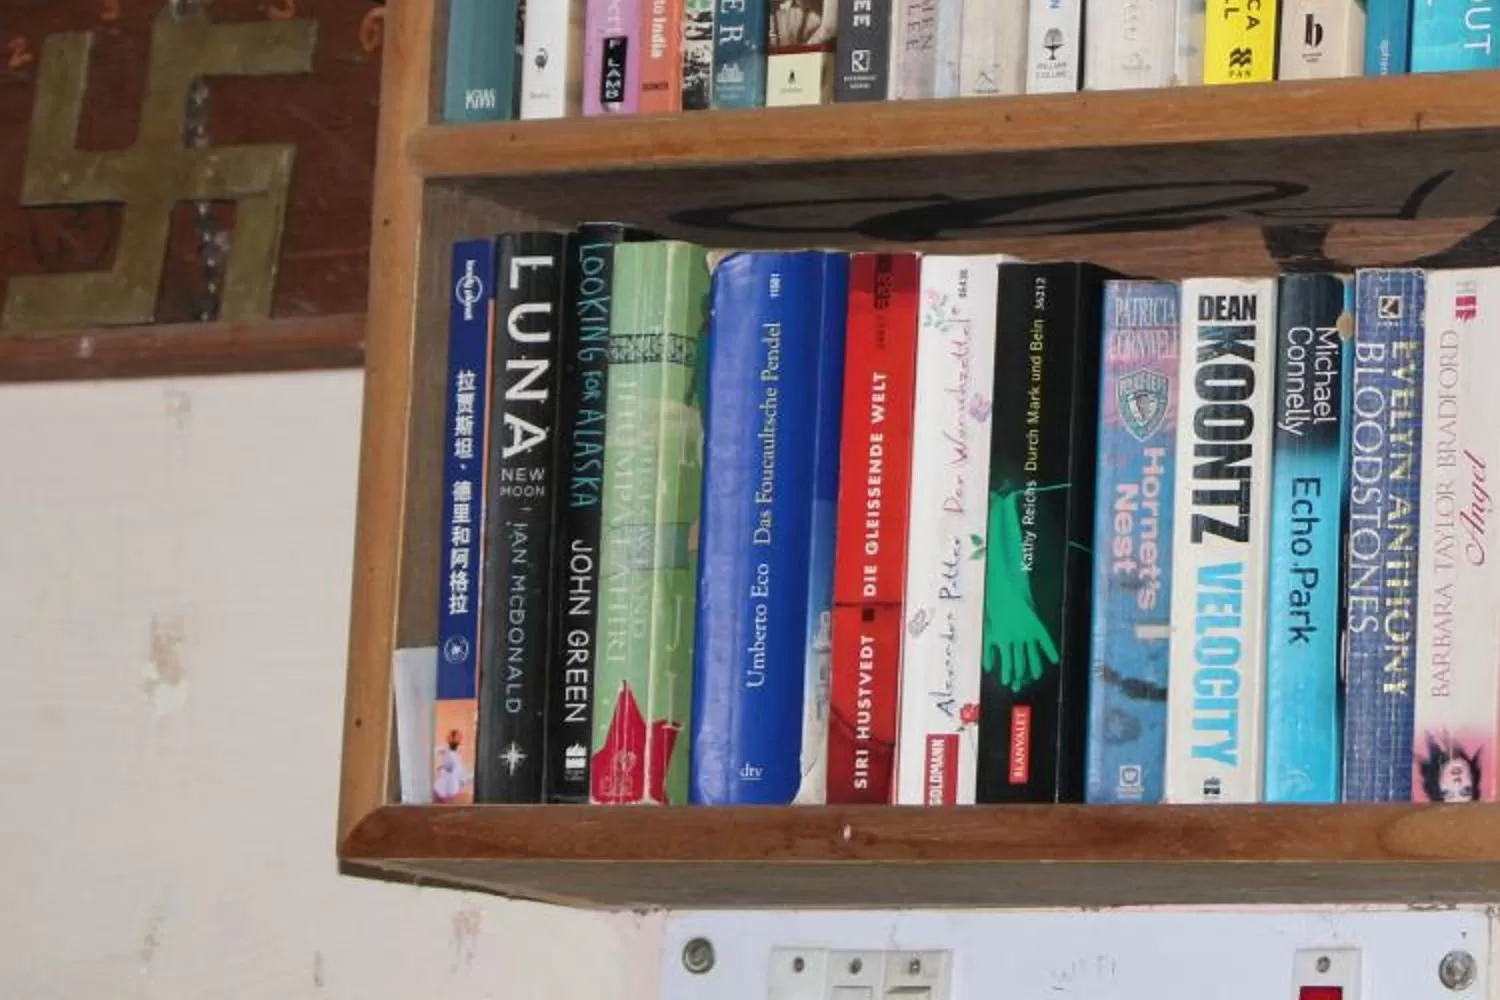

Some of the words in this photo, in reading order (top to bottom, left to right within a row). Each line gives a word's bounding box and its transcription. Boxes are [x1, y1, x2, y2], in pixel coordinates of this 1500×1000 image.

[652, 0, 665, 15] to
[652, 17, 665, 59] India
[1030, 318, 1044, 350] Bein
[1198, 295, 1257, 322] DEAN
[501, 255, 555, 460] LUNA
[760, 322, 782, 381] Pendel
[1030, 353, 1043, 381] und
[1312, 327, 1339, 425] Michael
[869, 372, 888, 424] WELT
[1028, 383, 1043, 425] Mark
[1277, 326, 1313, 437] Connelly
[755, 386, 779, 503] Foucaultsche
[1025, 427, 1040, 472] Durch
[1189, 325, 1257, 544] KOONTZ
[499, 485, 545, 497] MOON
[501, 467, 545, 481] NEW
[864, 432, 885, 556] GLEISSENDE
[1349, 342, 1386, 634] BLOODSTONES
[752, 506, 773, 545] Das
[1022, 478, 1038, 526] Reichs
[1290, 476, 1321, 558] Echo
[1020, 530, 1036, 572] Kathy
[569, 539, 593, 616] JOHN
[750, 563, 770, 597] Eco
[863, 565, 877, 597] DIE
[1288, 567, 1319, 645] Park
[746, 603, 770, 688] Umberto
[1191, 561, 1245, 767] VELOCITY
[564, 629, 589, 723] GREEN
[857, 635, 876, 740] HUSTVEDT
[854, 748, 870, 789] SIRI
